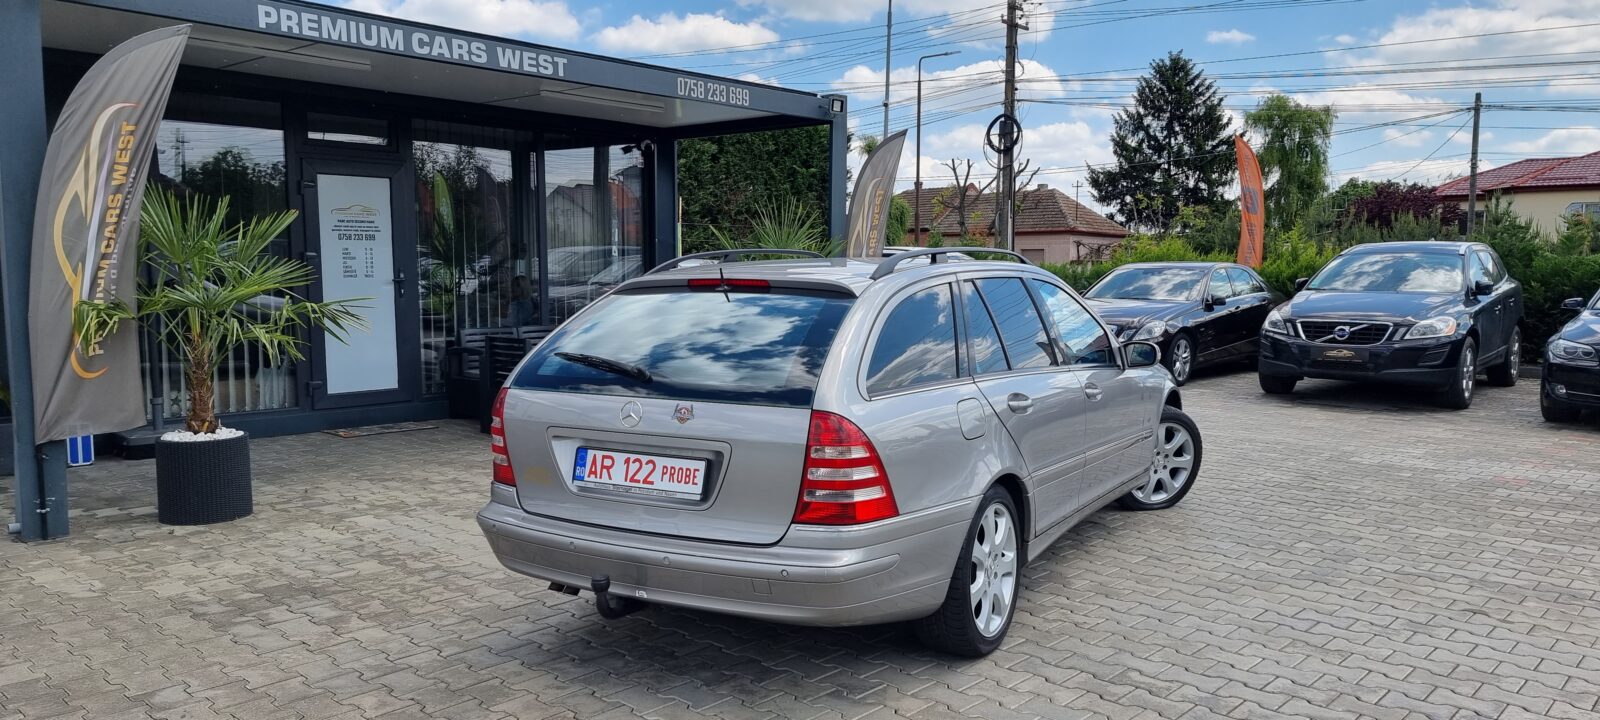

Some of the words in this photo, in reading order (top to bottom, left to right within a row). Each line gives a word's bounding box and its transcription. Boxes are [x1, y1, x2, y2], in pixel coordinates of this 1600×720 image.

[257, 4, 404, 51] PREMIUM
[411, 32, 488, 64] CARS
[496, 46, 567, 77] WEST
[677, 77, 705, 99] 0758
[707, 82, 727, 103] 233
[729, 86, 750, 106] 699
[111, 121, 137, 186] WEST
[101, 193, 122, 253] CARS
[338, 233, 353, 241] 0758
[353, 233, 364, 241] 233
[868, 230, 878, 256] ARS
[88, 260, 110, 357] PRIUM
[575, 466, 585, 477] RO
[587, 453, 615, 481] AR
[623, 456, 657, 485] 122
[660, 465, 700, 486] PROBE
